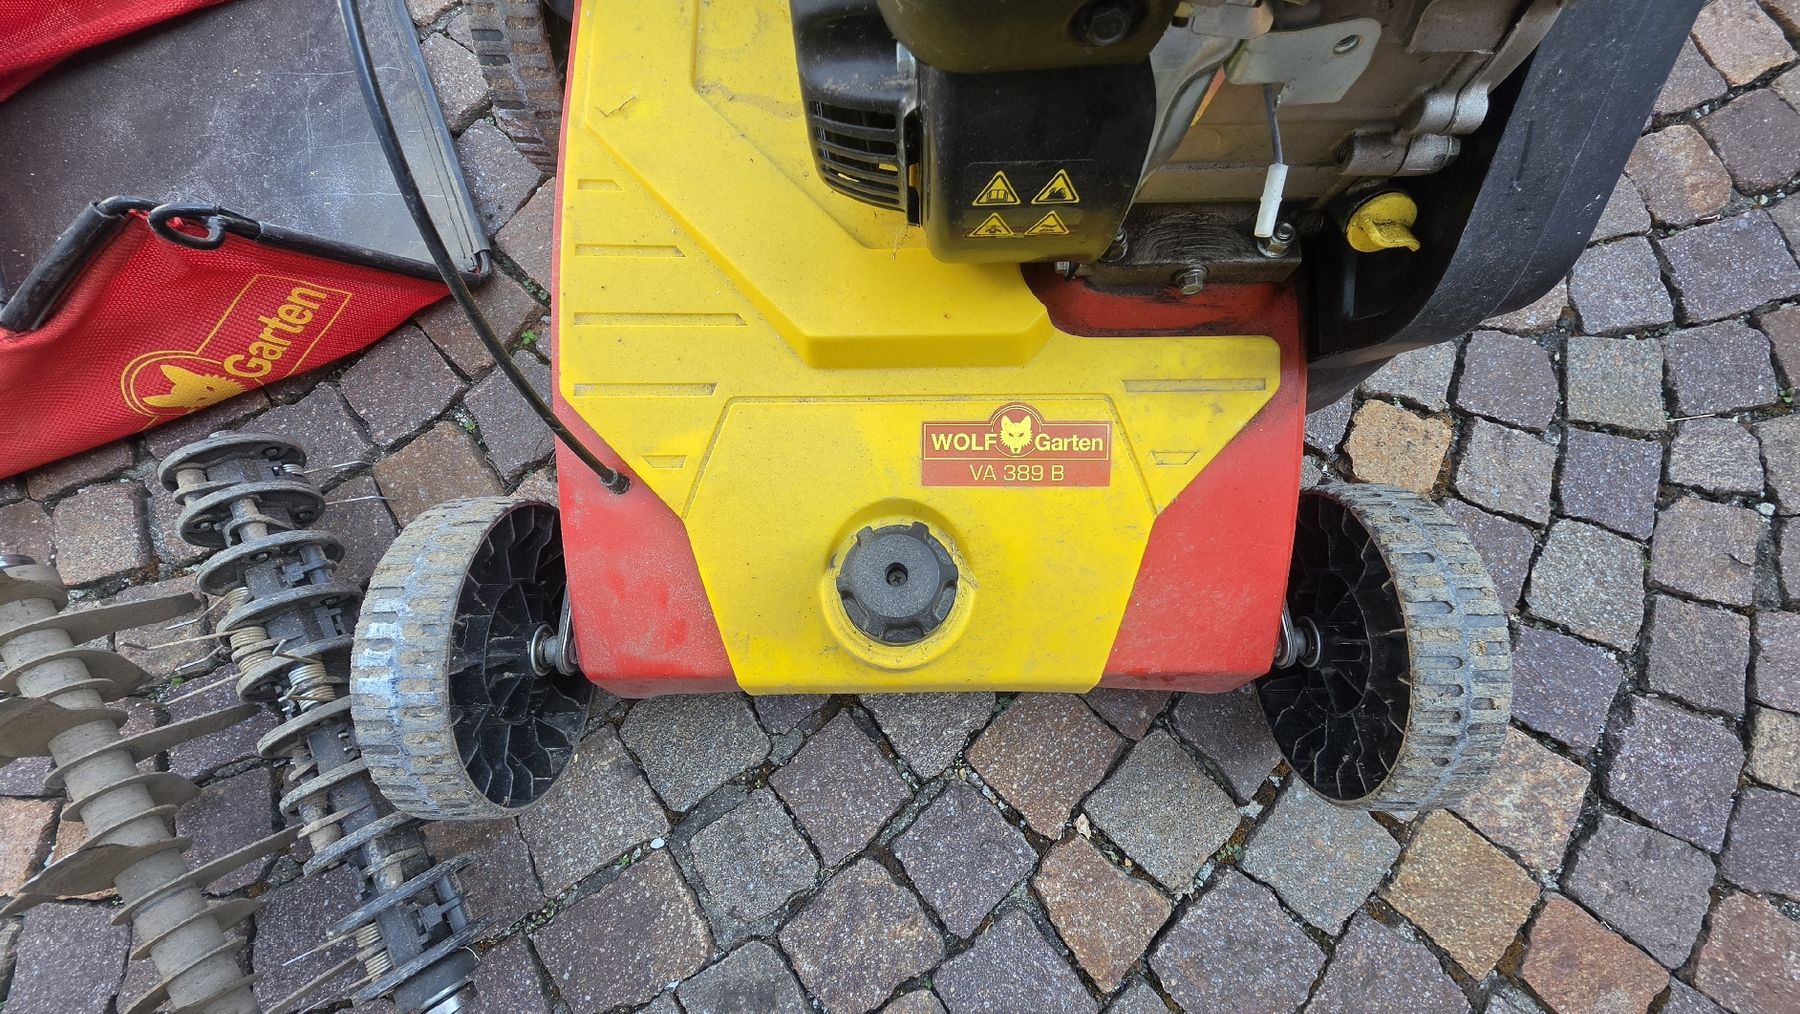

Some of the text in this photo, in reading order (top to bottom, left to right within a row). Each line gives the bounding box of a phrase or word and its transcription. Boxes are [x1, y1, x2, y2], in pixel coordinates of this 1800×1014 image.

[223, 286, 329, 378] Garten
[931, 433, 1104, 451] WOLF Garten
[969, 464, 1065, 481] VA 389 B
